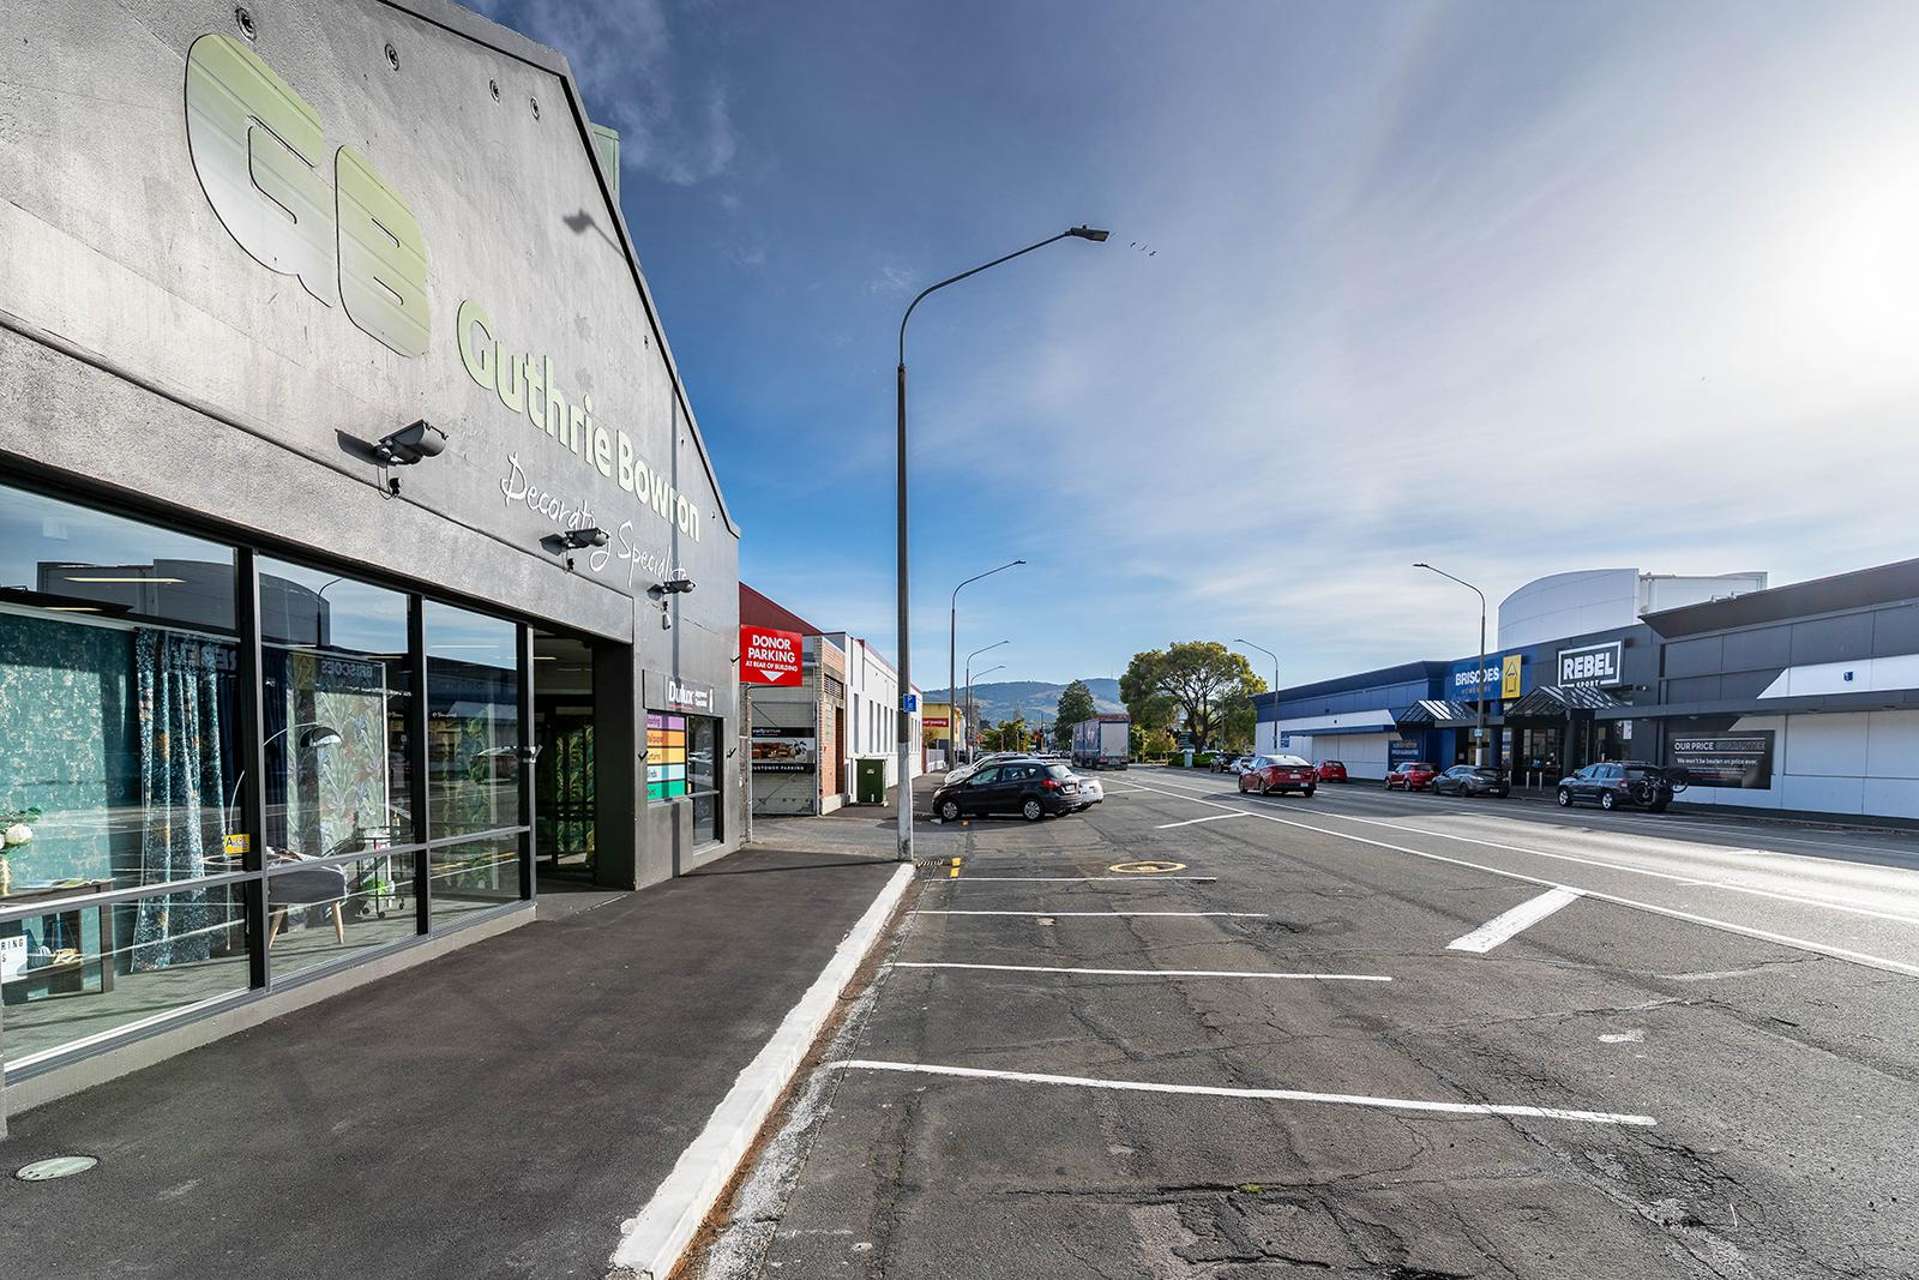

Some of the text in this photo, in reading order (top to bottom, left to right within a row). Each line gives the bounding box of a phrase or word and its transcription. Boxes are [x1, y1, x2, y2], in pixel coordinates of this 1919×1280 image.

[456, 299, 700, 543] Guthrie Bowron
[500, 451, 610, 572] Decoratig
[752, 634, 791, 650] DONOR
[748, 647, 795, 663] PARKING
[774, 664, 798, 672] BUILDING
[1563, 652, 1614, 680] REBEL
[668, 680, 694, 704] Dulux
[1576, 680, 1599, 688] SPORT
[1674, 742, 1691, 751] OUR
[1691, 741, 1714, 751] PRICE
